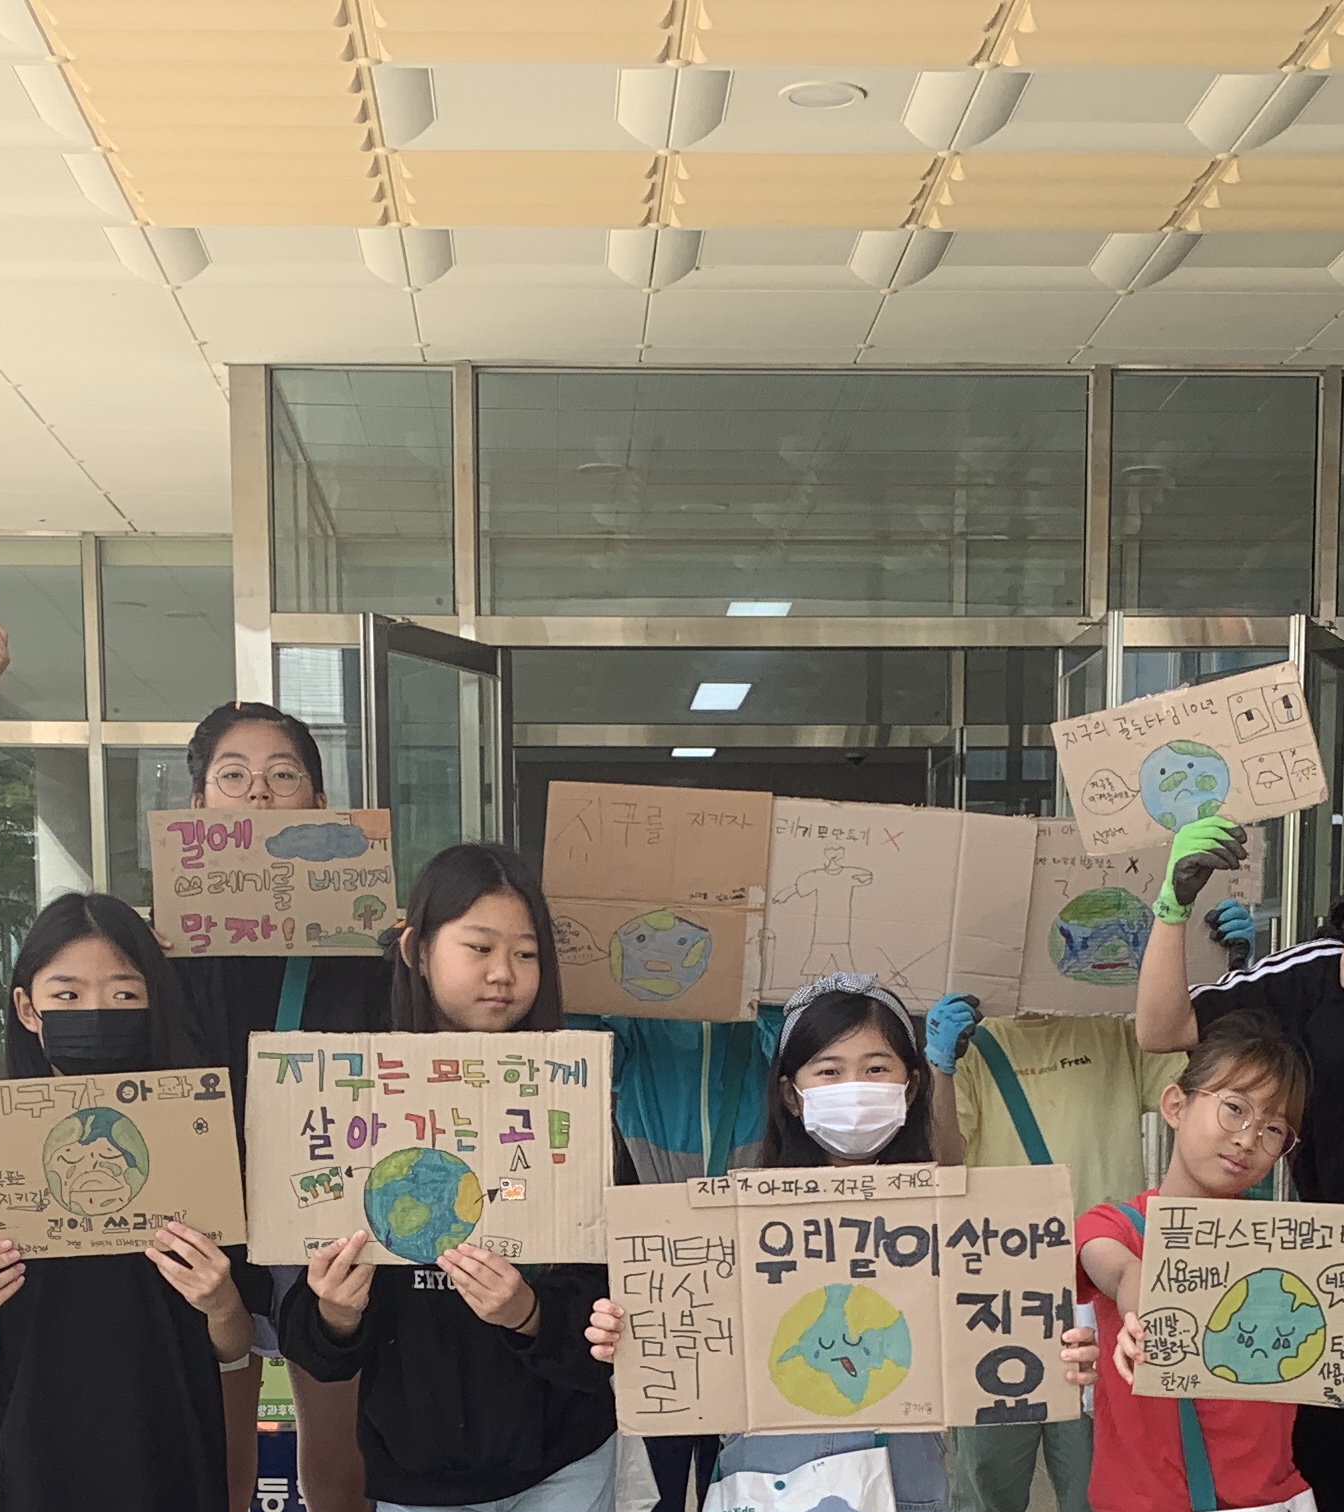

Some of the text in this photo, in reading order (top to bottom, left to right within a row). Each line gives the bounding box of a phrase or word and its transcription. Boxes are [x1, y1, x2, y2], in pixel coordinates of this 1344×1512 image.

[1062, 719, 1110, 750] 지구의
[687, 811, 754, 830] 지키자
[167, 818, 253, 869] 길에
[174, 861, 392, 911] 쓰레기를 버리지
[181, 913, 297, 954] 말자!
[258, 1049, 410, 1102] 지구는
[1059, 1054, 1092, 1069] Fresh
[115, 1072, 226, 1103] 아파요
[697, 1177, 753, 1196] 지구가
[757, 1178, 827, 1195] 아파요.
[831, 1175, 877, 1200] 지구를
[615, 1234, 737, 1279] 페트병
[945, 1215, 1073, 1276] 살아요
[623, 1269, 714, 1310] 대신
[1151, 1257, 1231, 1294] 사용해요!
[630, 1308, 735, 1360] 텀블러
[975, 1345, 1048, 1425] 요
[1160, 1371, 1202, 1392] 한지우
